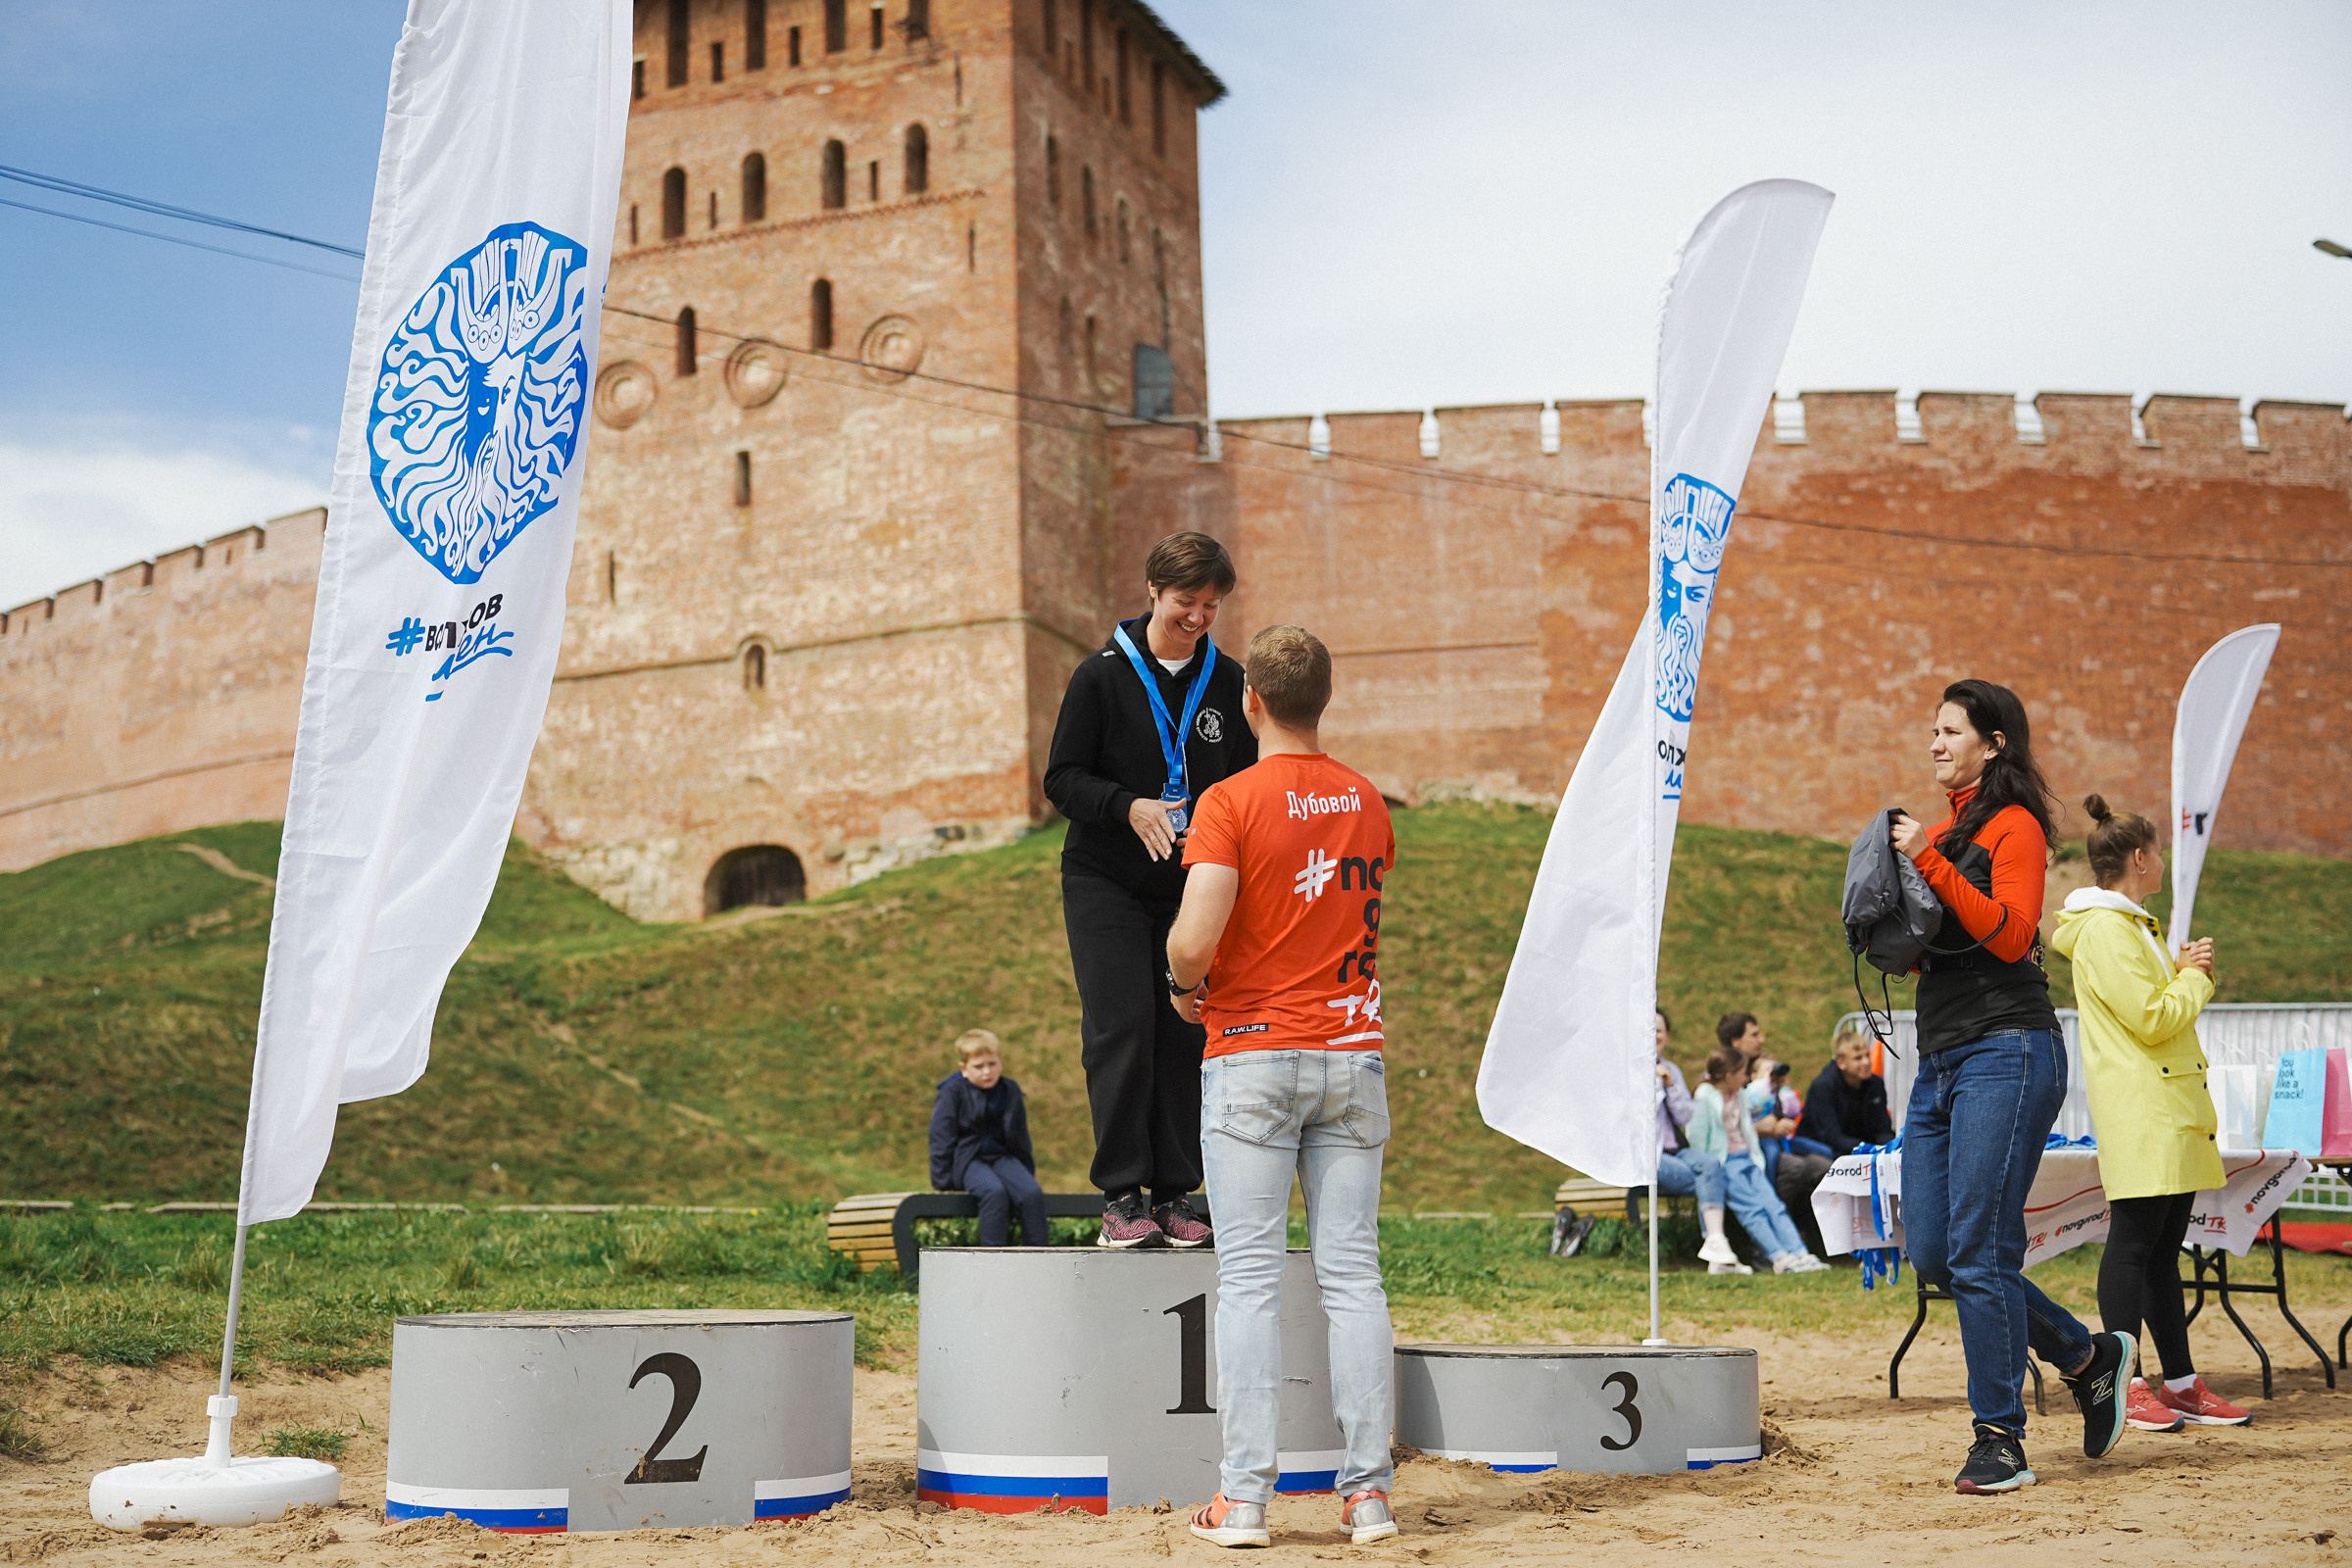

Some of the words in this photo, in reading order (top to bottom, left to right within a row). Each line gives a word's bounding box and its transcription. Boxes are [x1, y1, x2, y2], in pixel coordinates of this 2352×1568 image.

[1285, 786, 1362, 821] Дубовой
[2280, 1057, 2294, 1067] You
[1162, 1293, 1217, 1414] 1
[623, 1351, 709, 1485] 2
[1599, 1370, 1642, 1451] 3
